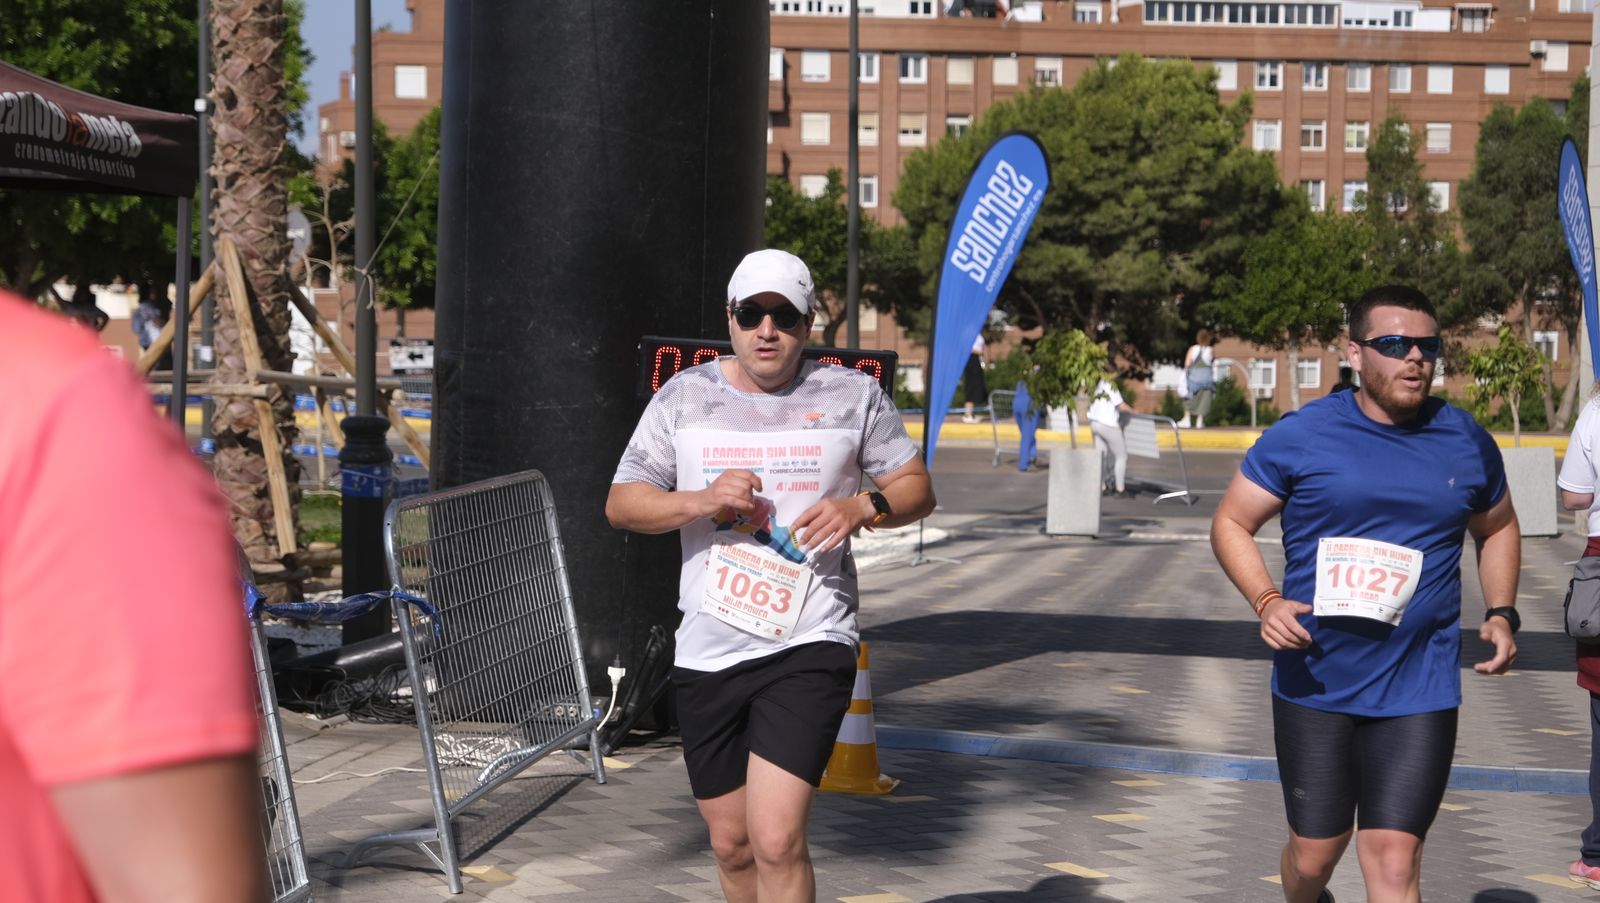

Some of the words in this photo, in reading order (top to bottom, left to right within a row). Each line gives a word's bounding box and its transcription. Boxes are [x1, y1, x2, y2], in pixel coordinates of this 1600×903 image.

[77, 112, 142, 158] meta
[15, 142, 87, 172] cronometraje
[88, 154, 136, 179] deportivo
[712, 447, 763, 459] CARRERA
[766, 446, 787, 458] SIN
[789, 445, 822, 457] HUMO
[776, 482, 784, 491] 4
[788, 481, 819, 491] JUNIO
[762, 559, 778, 571] SIN
[1327, 563, 1409, 597] 1027
[716, 565, 792, 614] 1063
